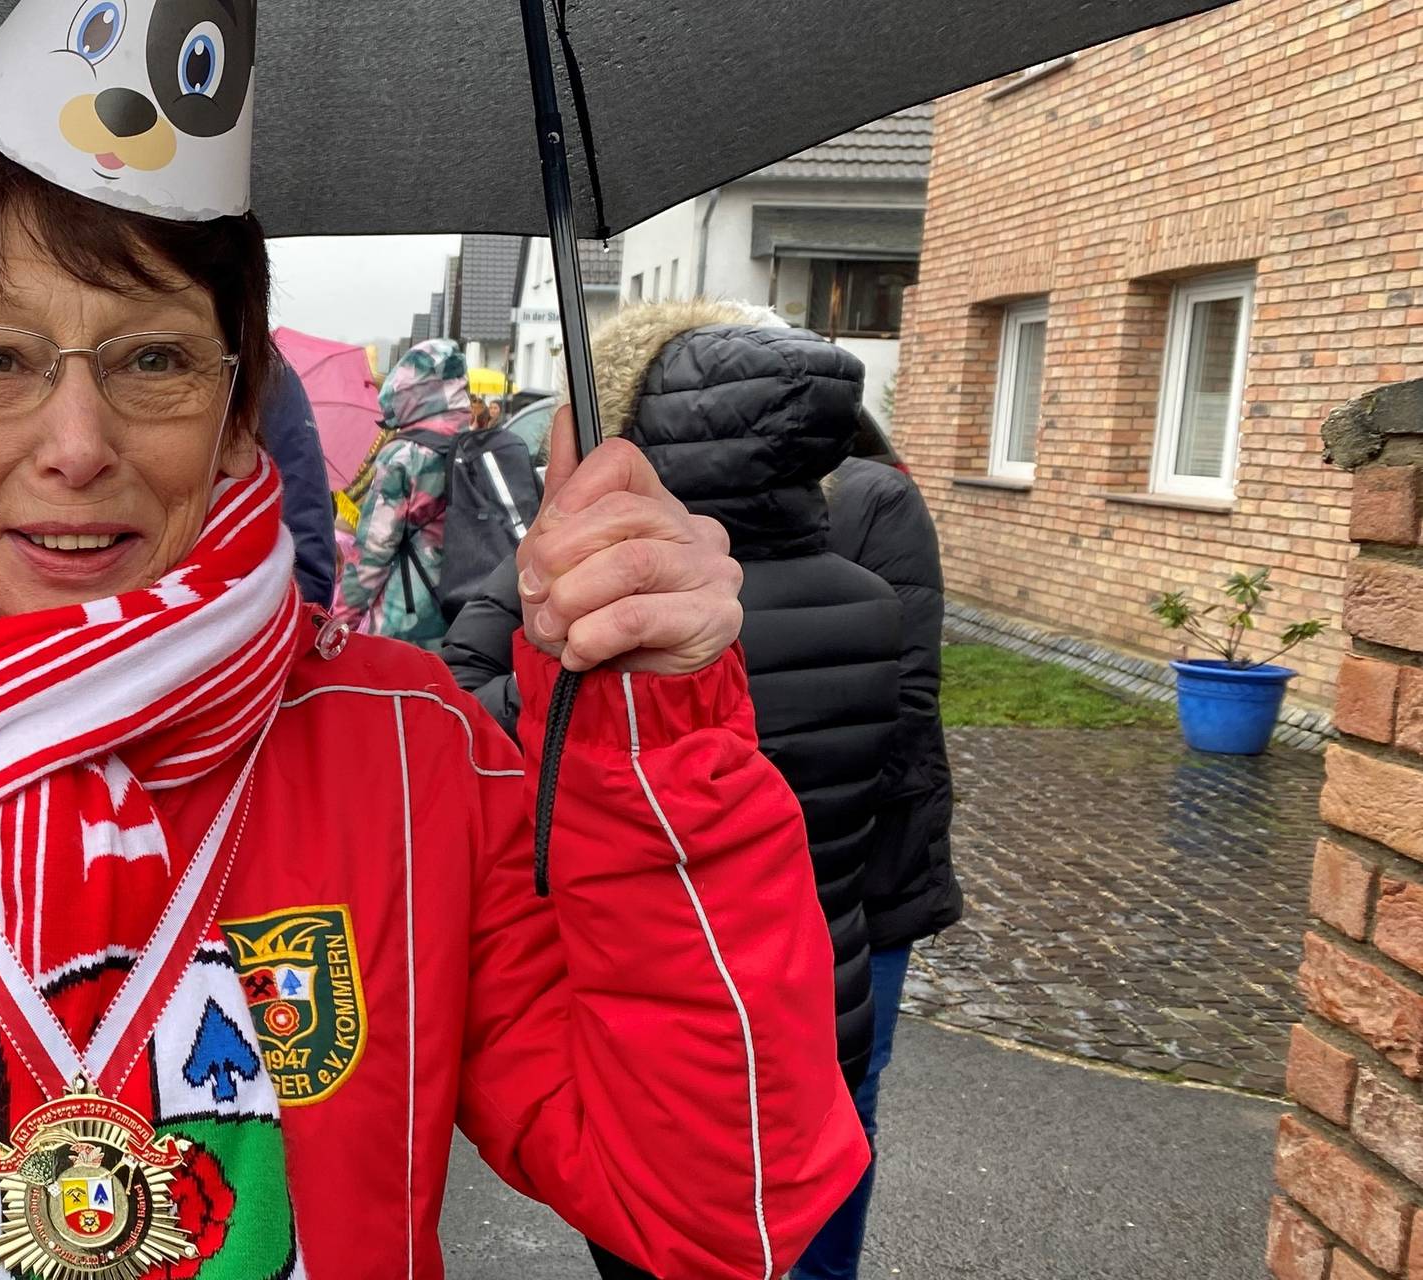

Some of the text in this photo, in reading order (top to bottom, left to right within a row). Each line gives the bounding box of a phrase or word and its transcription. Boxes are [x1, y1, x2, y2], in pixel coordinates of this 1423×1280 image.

[523, 312, 531, 321] In
[532, 312, 545, 321] der
[325, 934, 356, 1050] KOMMERN
[263, 1048, 312, 1071] 1947
[317, 1050, 348, 1084] e.V.
[83, 1103, 108, 1116] 1947
[109, 1106, 150, 1140] Kommern
